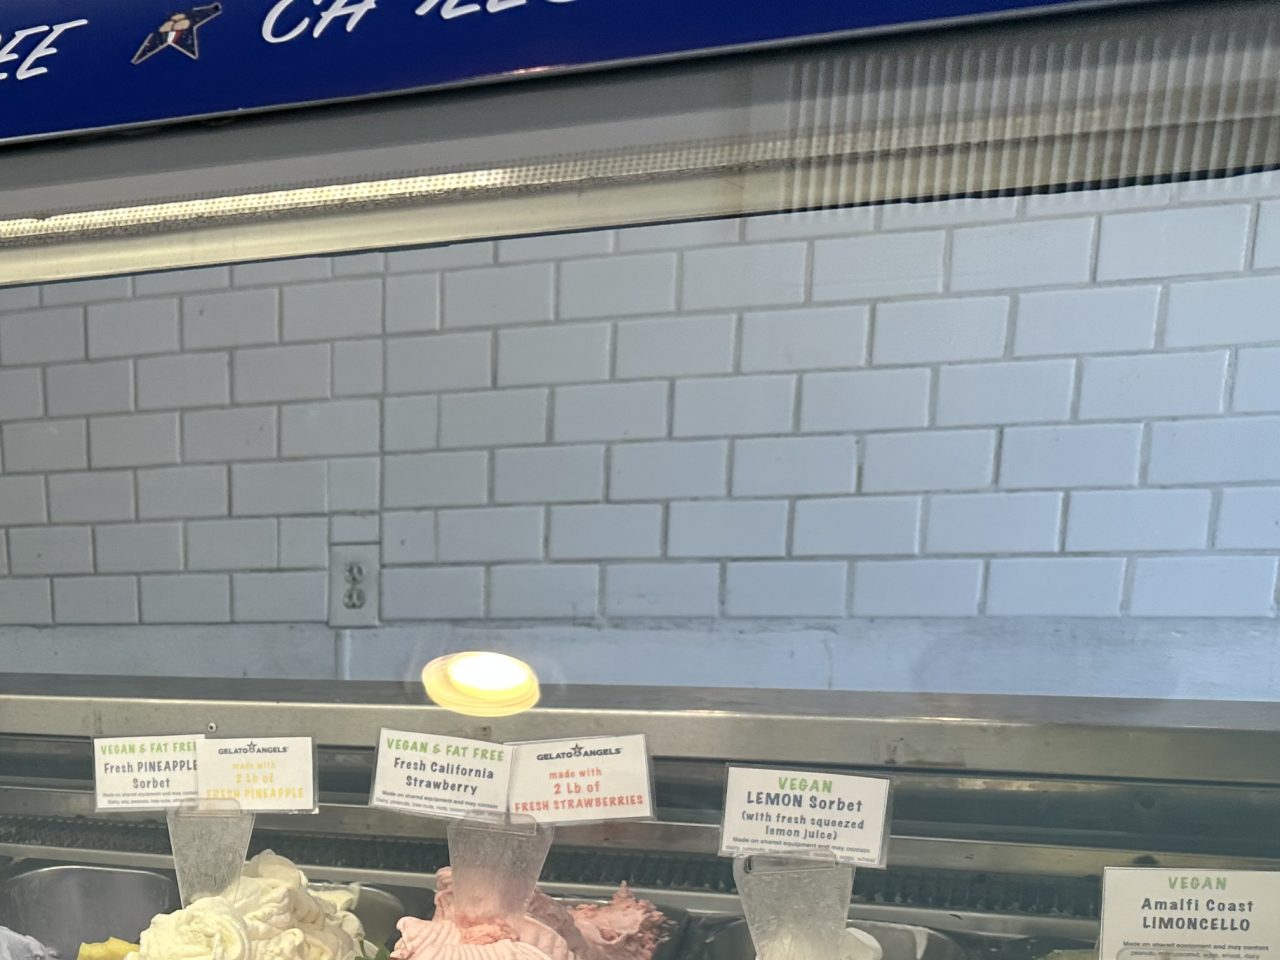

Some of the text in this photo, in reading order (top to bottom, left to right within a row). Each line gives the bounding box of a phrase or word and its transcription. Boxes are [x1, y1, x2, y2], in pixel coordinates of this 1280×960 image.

[100, 743, 136, 756] VEGAN
[150, 742, 169, 753] FAT
[386, 738, 428, 753] VEGAN
[446, 745, 469, 758] FAT
[473, 749, 505, 762] FREE
[537, 748, 621, 761] GELATO ANGELS
[104, 759, 197, 774] Fresh PINEAPPLE
[394, 757, 494, 779] Fresh California
[549, 768, 602, 780] made with
[132, 777, 170, 789] Sorbet
[406, 775, 478, 795] Strawberry
[554, 781, 601, 795] 2 Lb of
[778, 776, 833, 793] VEGAN
[244, 787, 304, 799] PINEAPPLE
[514, 801, 549, 813] FRESH
[554, 795, 644, 810] STRAWBERRIES
[747, 791, 863, 812] LEMON Sorbet
[742, 810, 865, 830] (with fresh squeezed
[766, 825, 838, 841] lemon juice)
[1168, 877, 1227, 890] VEGAN
[1141, 898, 1254, 912] Amalfi Coast
[1143, 916, 1250, 931] LIMONCELLO
